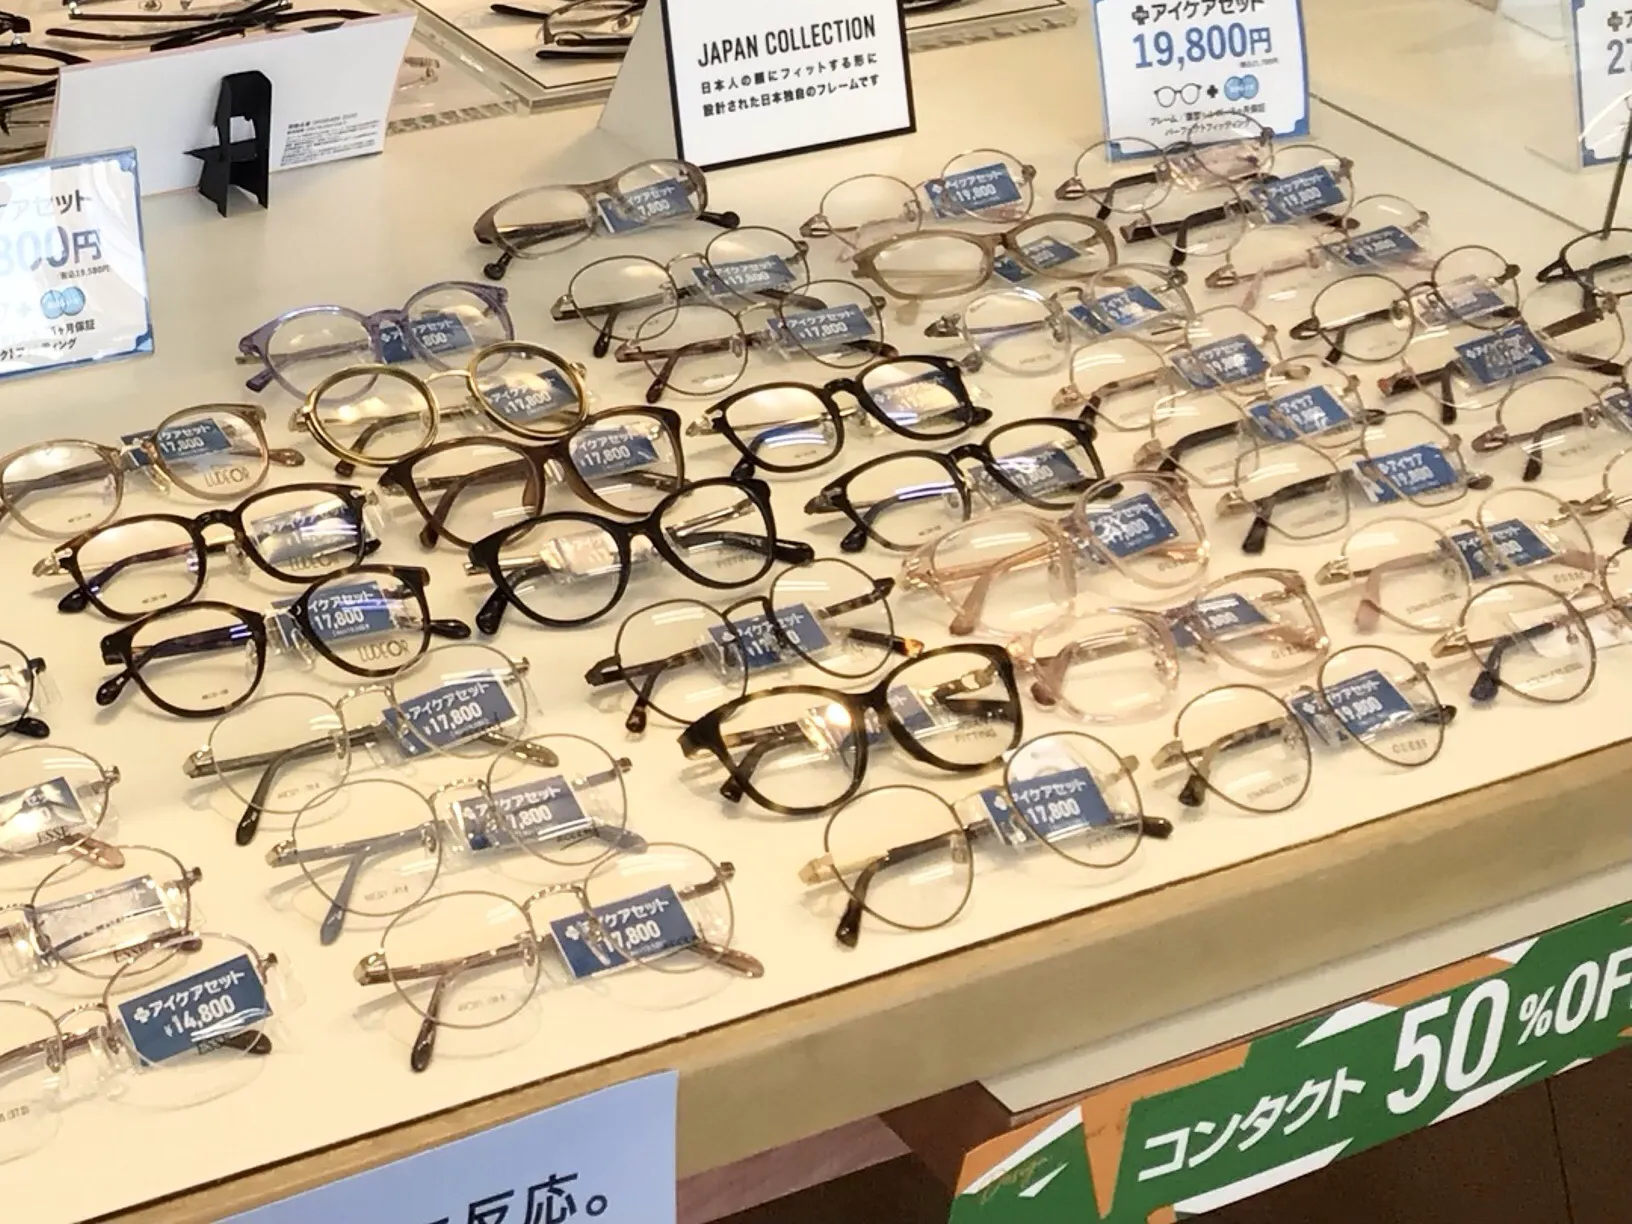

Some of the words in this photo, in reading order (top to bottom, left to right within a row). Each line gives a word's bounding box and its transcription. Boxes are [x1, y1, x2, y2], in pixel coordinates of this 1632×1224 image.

[698, 34, 759, 68] JAPAN
[765, 14, 876, 56] COLLECTION
[1132, 22, 1272, 71] 19,800円
[701, 52, 878, 94] 日本人の顔にフィットする形に
[408, 681, 490, 716] アイケアセット
[422, 701, 482, 737] ¥17,800
[148, 969, 245, 1017] アイケアセット
[1137, 1066, 1368, 1182] コンタクト
